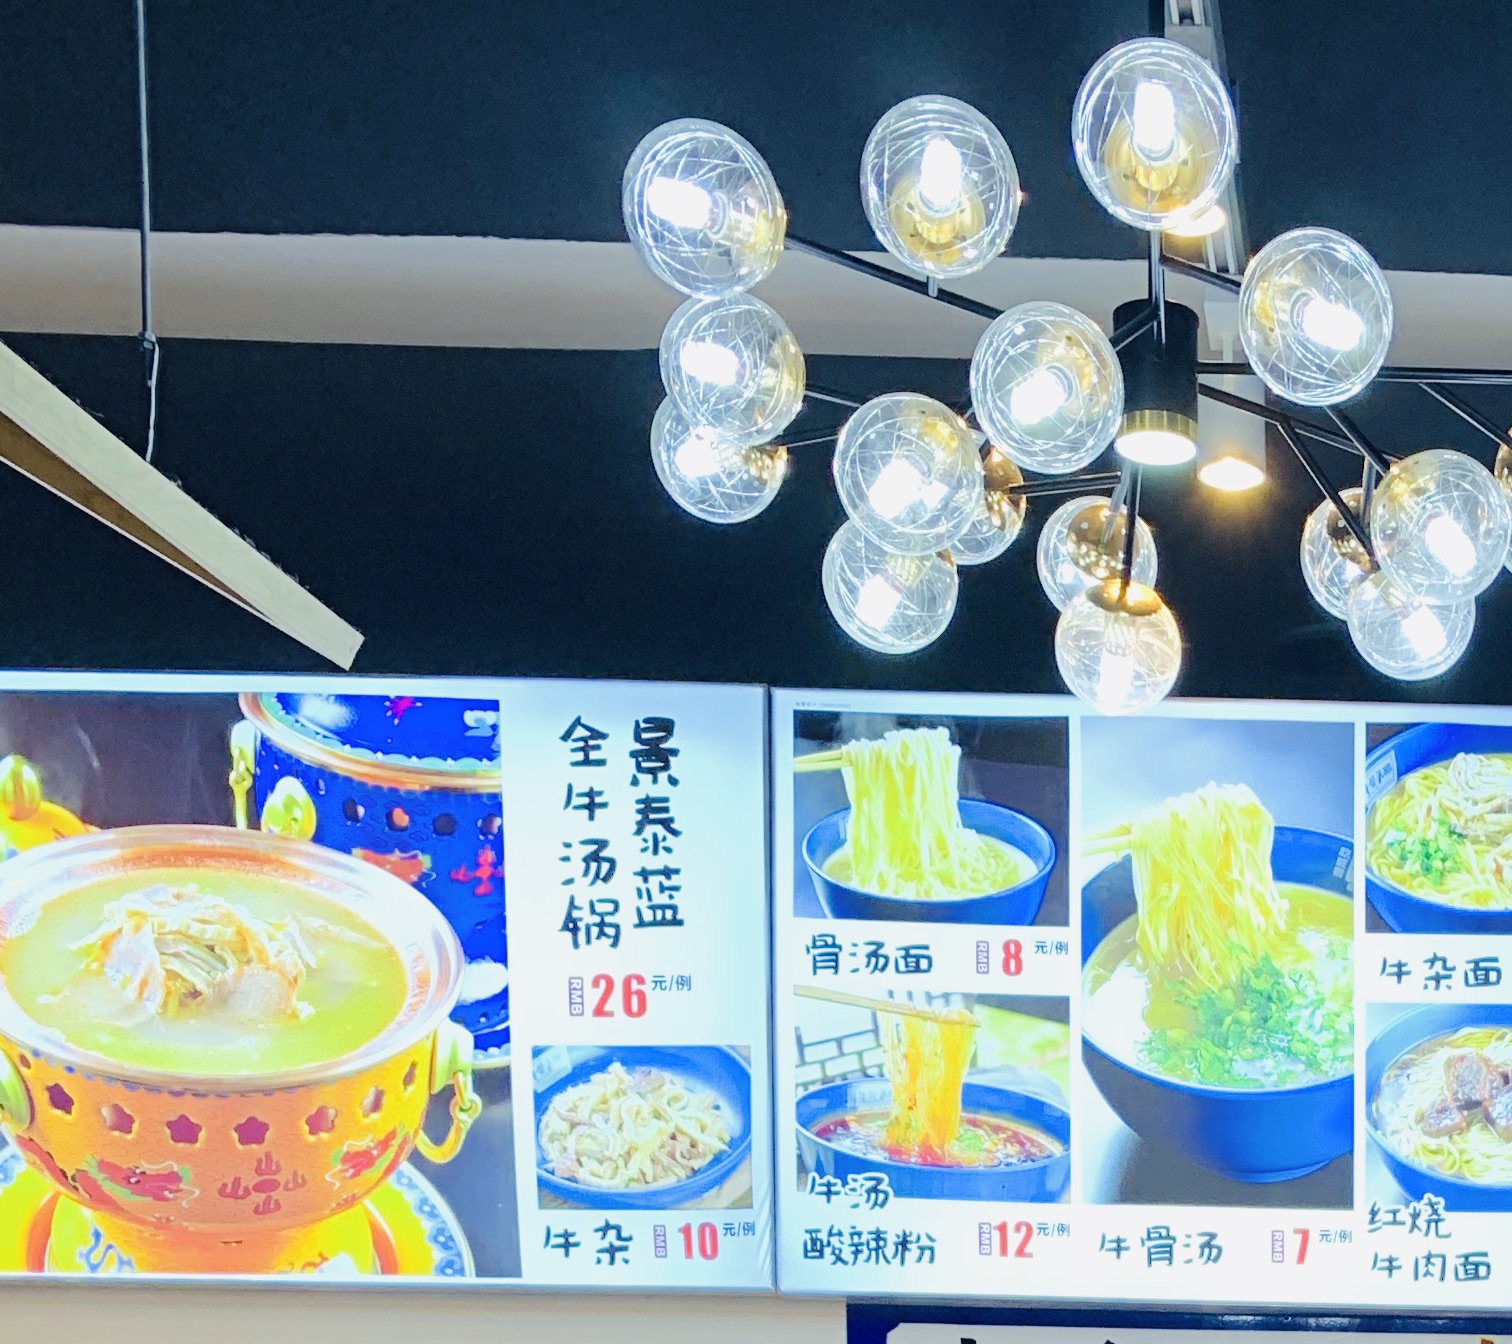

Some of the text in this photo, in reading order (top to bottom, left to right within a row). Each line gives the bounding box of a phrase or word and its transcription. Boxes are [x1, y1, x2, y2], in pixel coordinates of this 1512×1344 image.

[559, 715, 621, 949] 全牛汤锅
[629, 716, 684, 928] 景泰蓝
[806, 934, 1068, 976] 骨汤面 RMB 8 元/例
[1381, 952, 1502, 991] 牛杂面
[570, 974, 691, 1018] RMB 26 元/例
[807, 1173, 890, 1210] 牛汤
[1367, 1197, 1451, 1239] 红烧
[544, 1219, 633, 1265] 牛杂
[655, 1227, 666, 1257] RMB
[678, 1222, 718, 1260] 10
[803, 1221, 1070, 1266] 酸辣粉 RMB 12 元/例
[1100, 1226, 1352, 1267] 牛骨汤 RMB 7 元/例
[1372, 1250, 1491, 1282] 牛肉面
